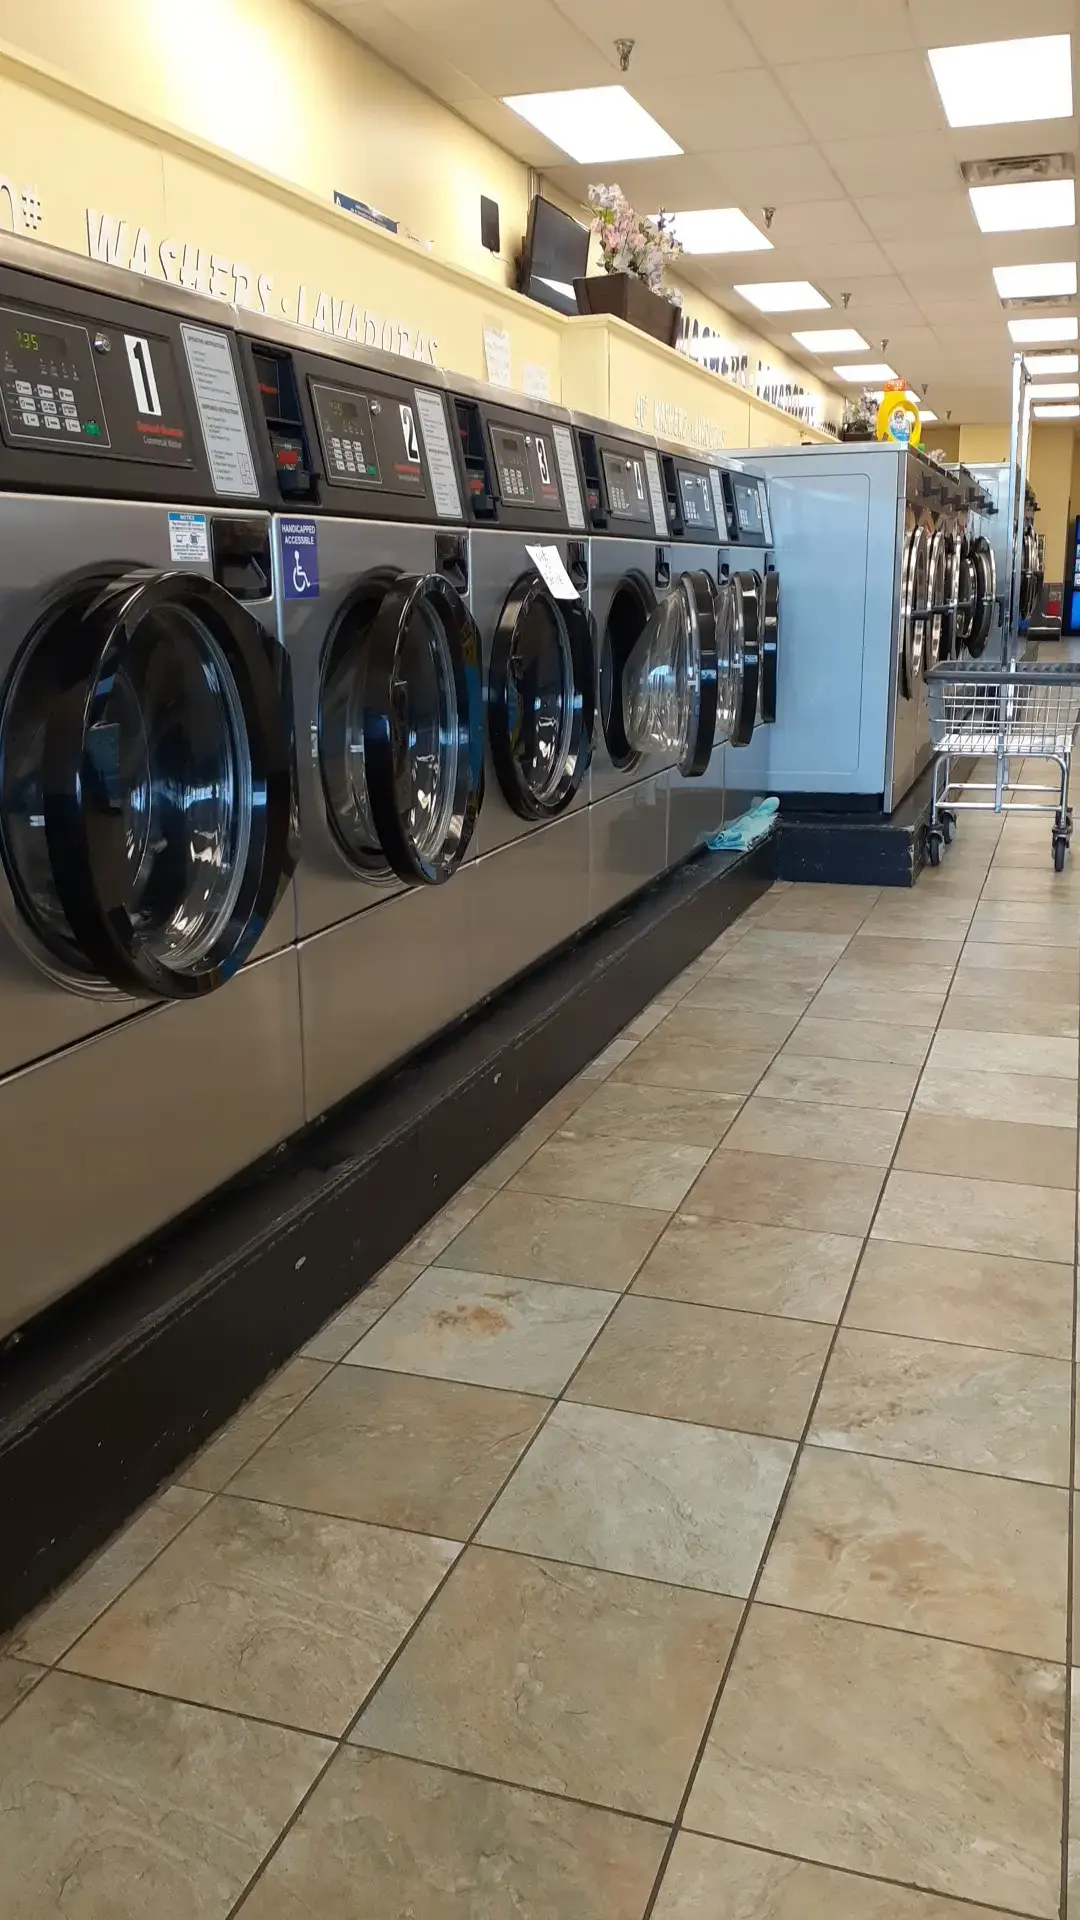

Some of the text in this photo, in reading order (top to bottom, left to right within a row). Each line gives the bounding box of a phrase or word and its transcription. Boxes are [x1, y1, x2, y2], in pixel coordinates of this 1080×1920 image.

[85, 207, 273, 313] WASHERS
[133, 341, 155, 413] 1
[402, 407, 419, 459] 2
[536, 439, 548, 482] 3
[281, 523, 316, 535] HANDICAPPED
[284, 535, 315, 545] ACCESSIBLE
